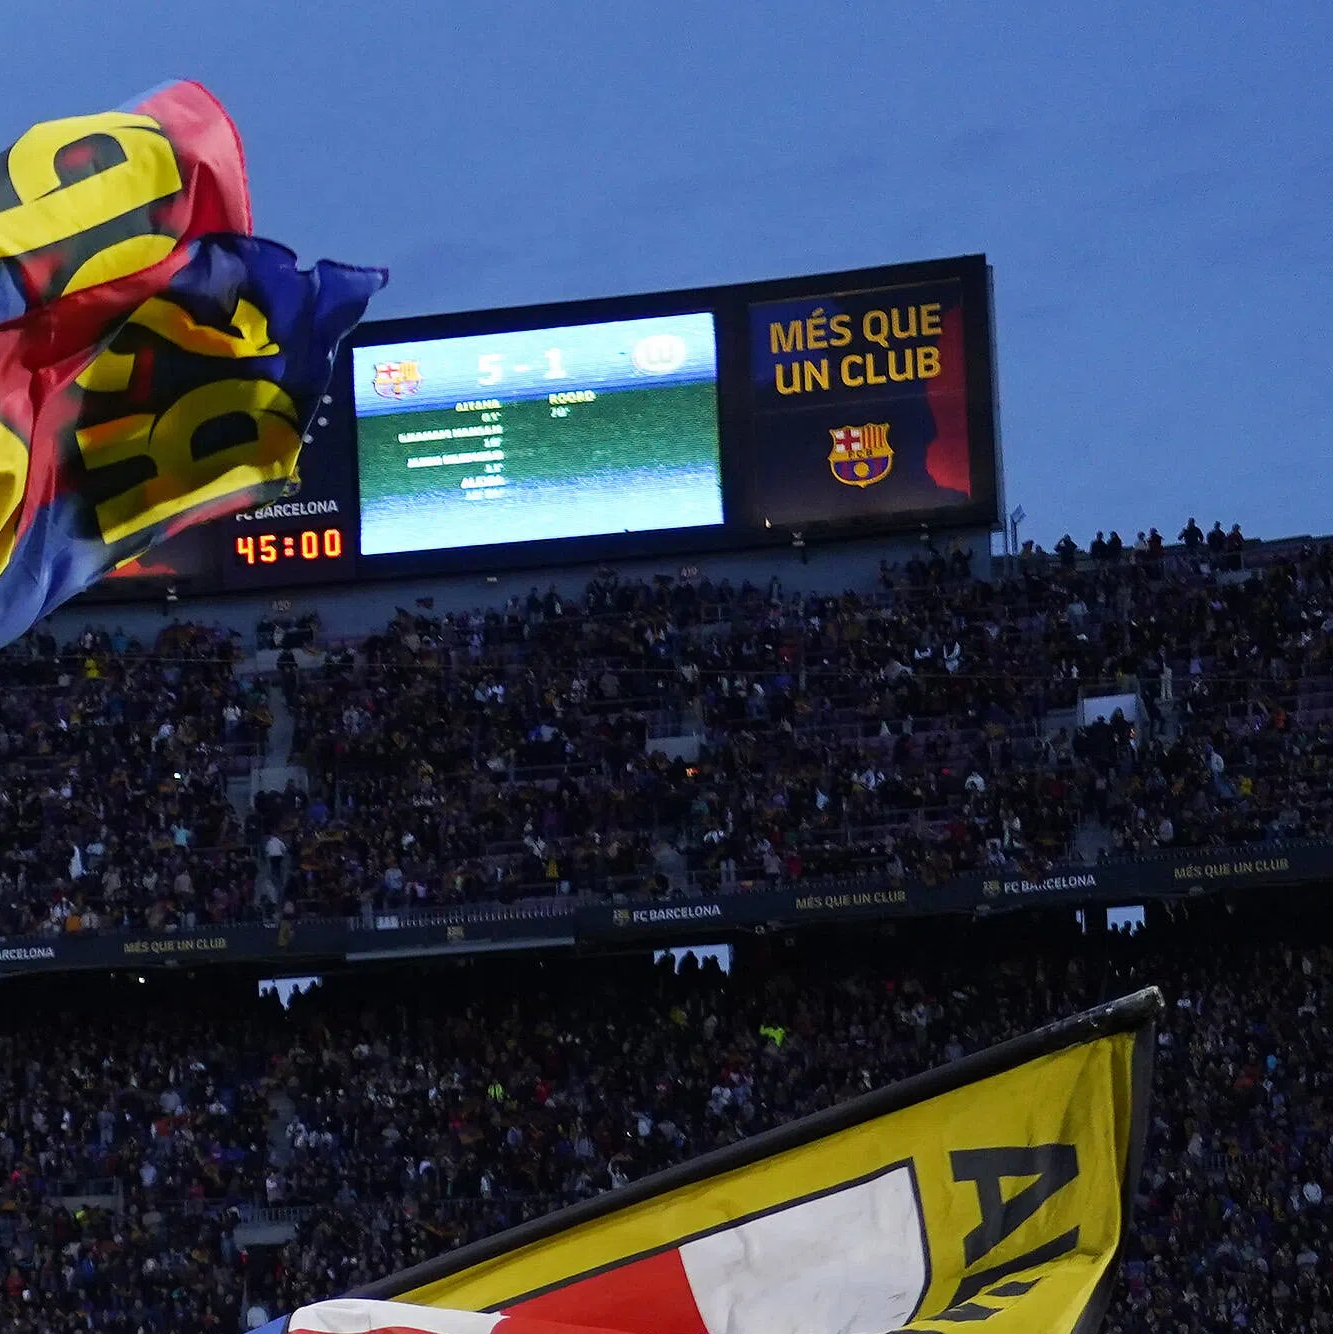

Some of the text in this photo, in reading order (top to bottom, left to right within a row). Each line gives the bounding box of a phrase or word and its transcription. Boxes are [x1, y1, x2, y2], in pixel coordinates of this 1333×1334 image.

[769, 303, 942, 354] MÉS QUE
[477, 353, 503, 387] 5
[543, 348, 567, 379] 1
[775, 346, 941, 395] UN CLUB
[236, 528, 342, 565] 45:00
[1205, 863, 1231, 878] QUE
[1234, 861, 1252, 874] UN
[1255, 858, 1289, 873] CLUB
[825, 894, 850, 908] QUE
[852, 893, 871, 905] UN
[1004, 881, 1019, 894] FC
[633, 904, 721, 922] FC BARCELONA
